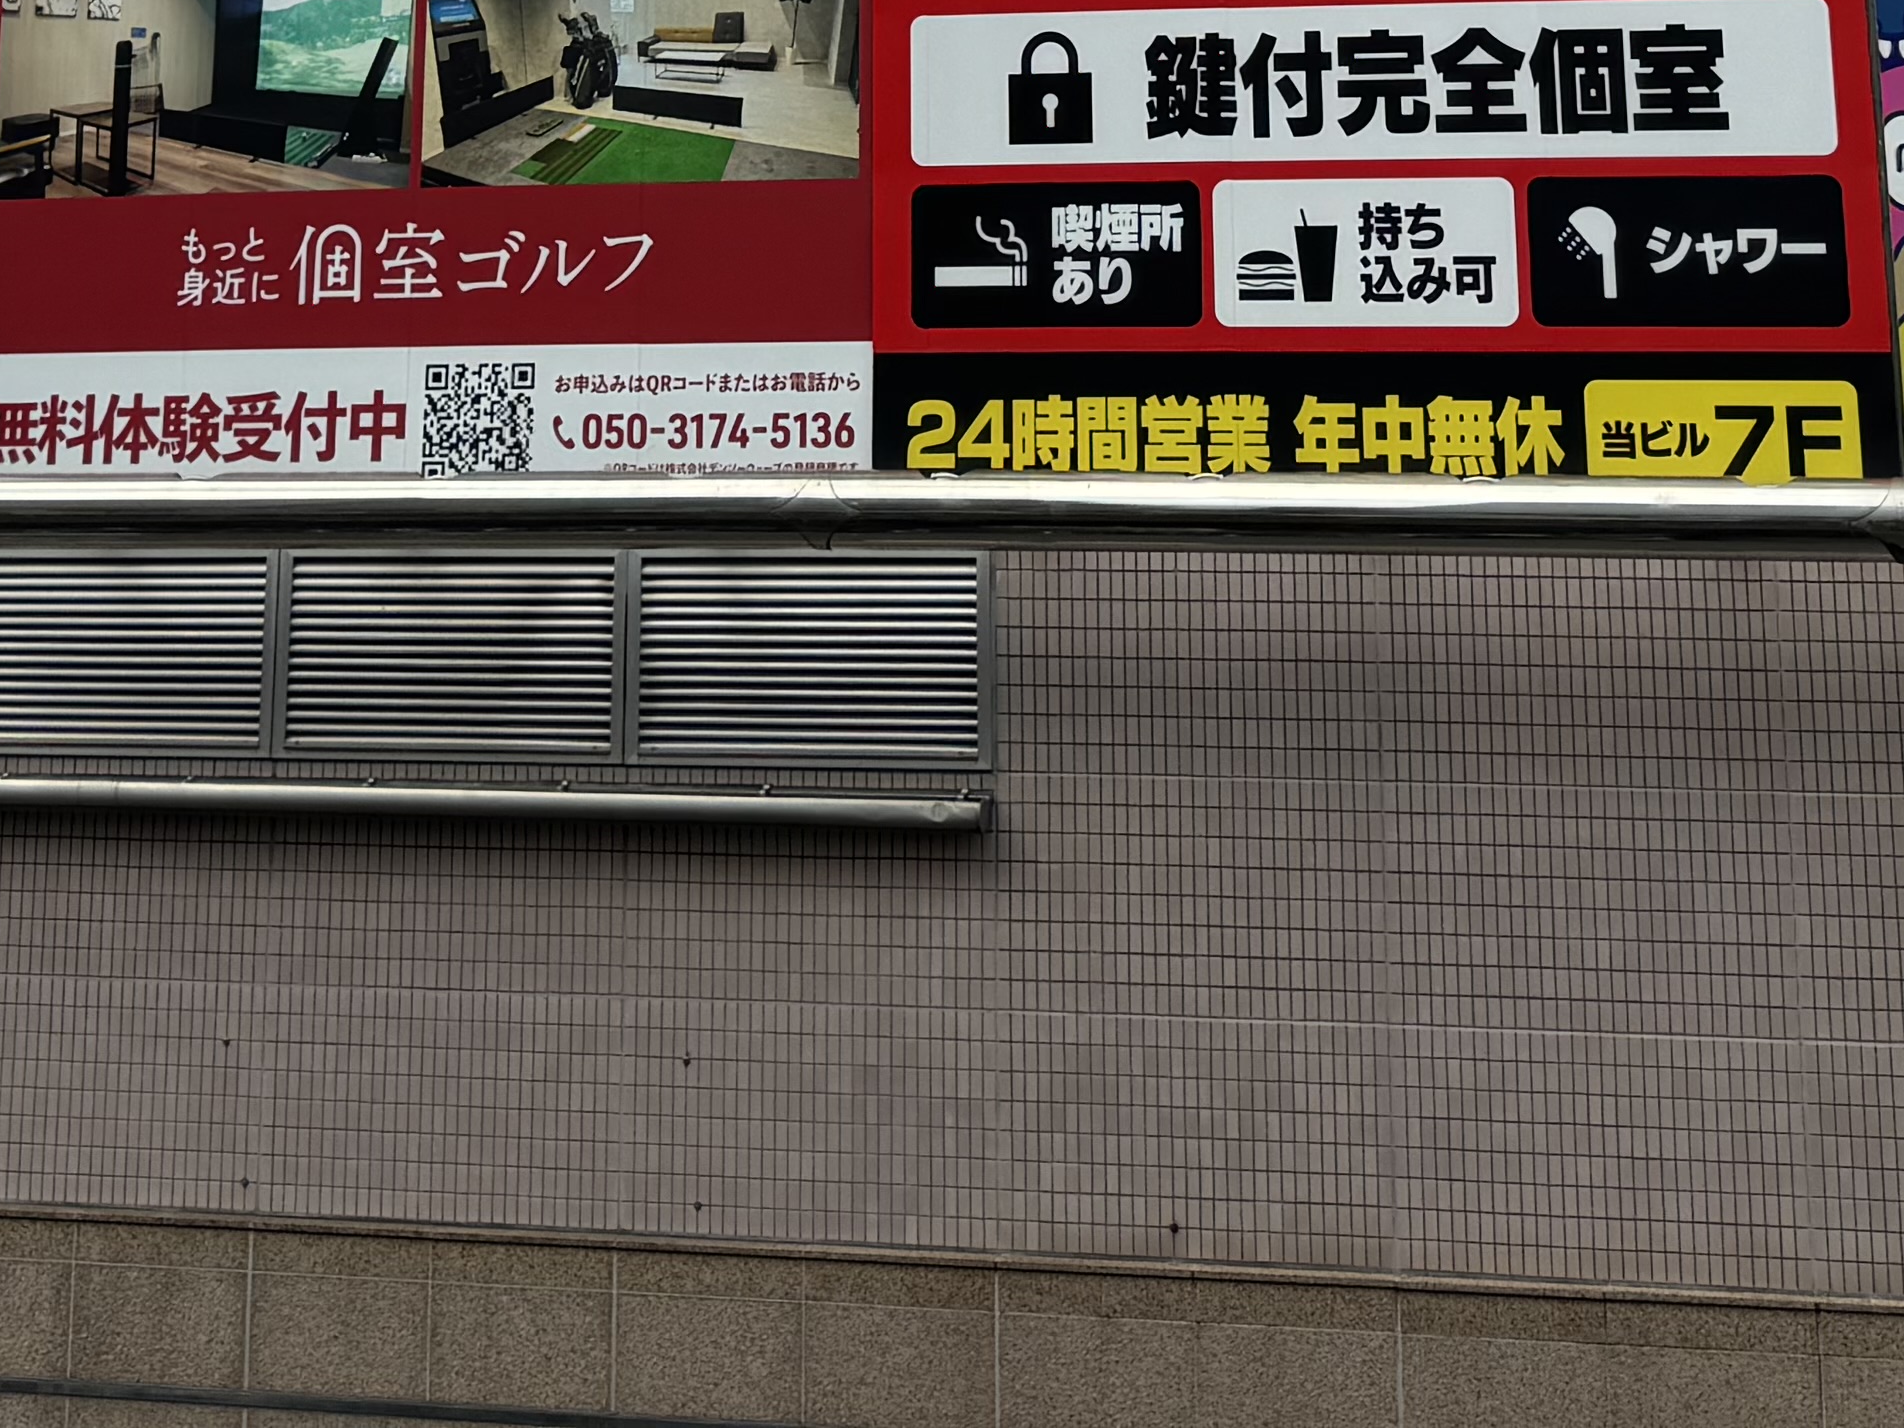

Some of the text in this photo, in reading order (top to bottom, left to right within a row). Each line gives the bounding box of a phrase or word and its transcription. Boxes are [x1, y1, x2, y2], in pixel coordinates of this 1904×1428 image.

[1145, 24, 1729, 139] 鍵付完全個室
[182, 227, 265, 263] もっと
[1051, 202, 1183, 252] 喫煙所
[1358, 202, 1446, 248] 持ち
[289, 221, 655, 306] 個室ゴルフ
[1647, 226, 1825, 274] シャワー
[176, 269, 279, 308] 身近に
[1052, 256, 1133, 304] あり
[1360, 254, 1496, 304] 込み可
[554, 372, 861, 395] お申込みはQRコードまたはお電話から
[582, 412, 855, 450] 050-3174-5136
[906, 393, 1564, 475] 24時間営業 年中無休
